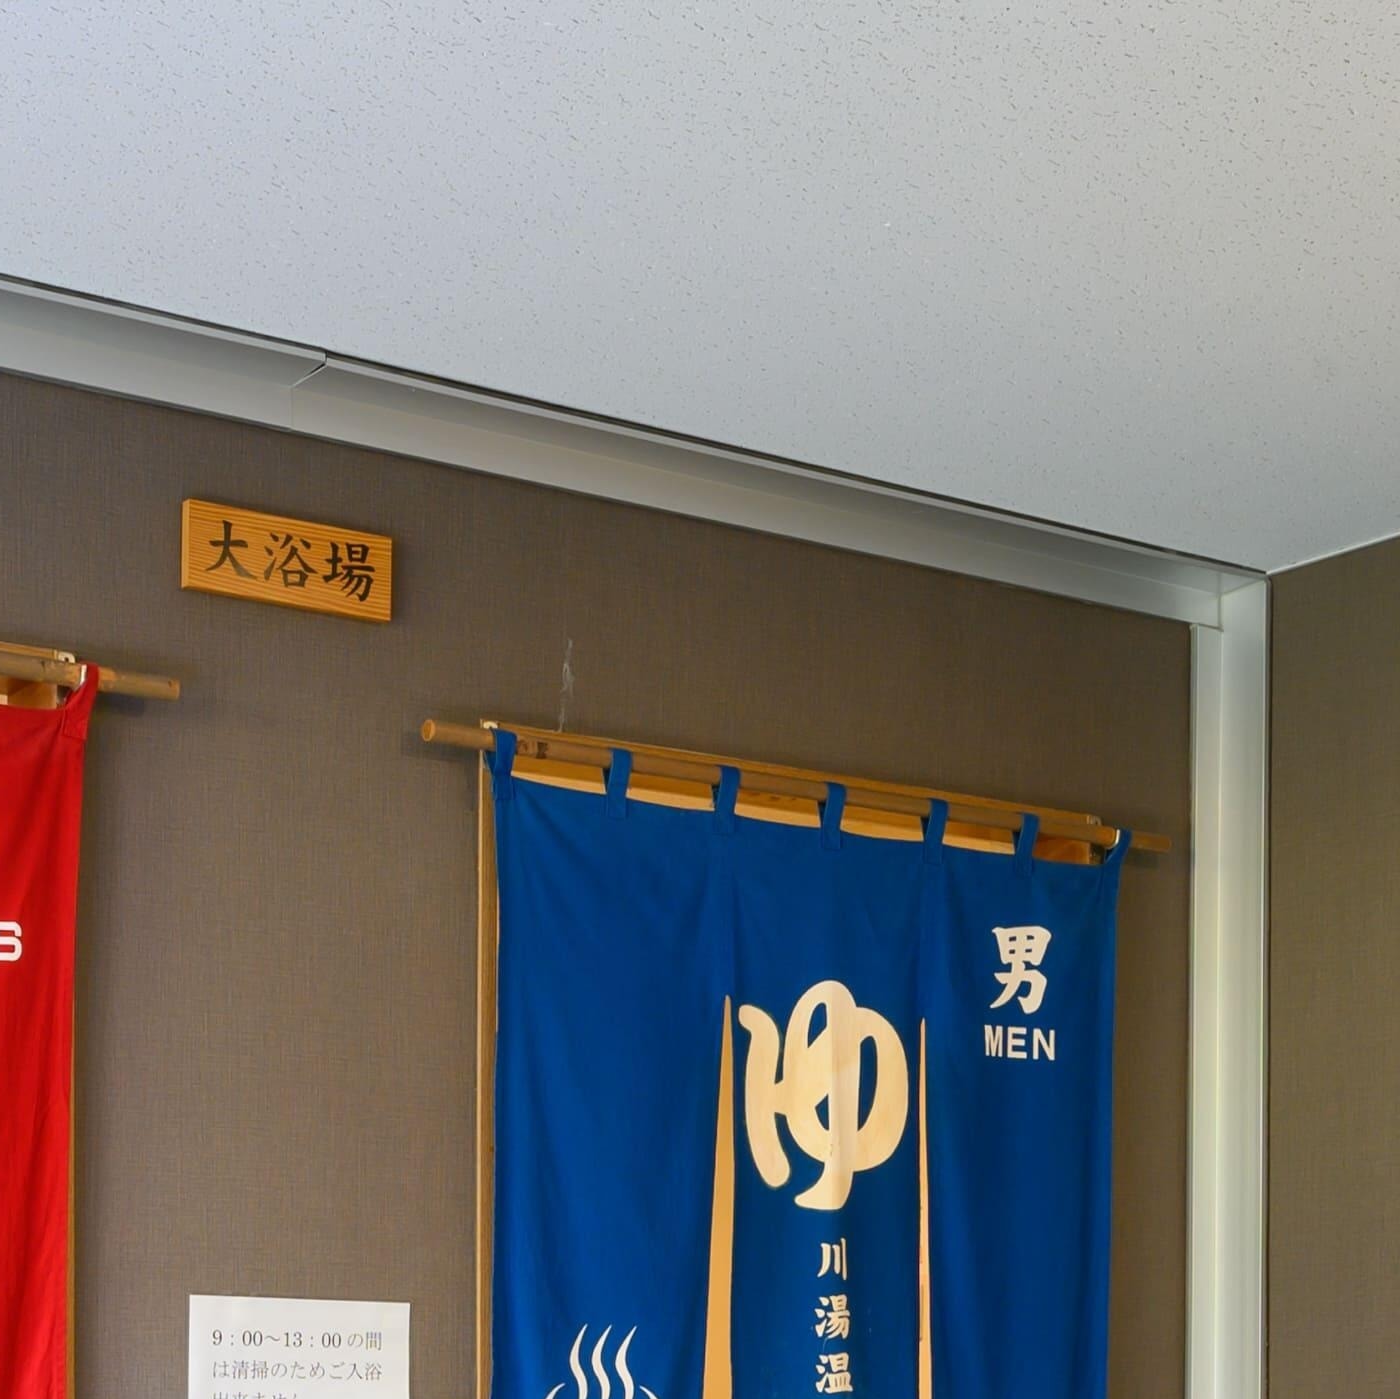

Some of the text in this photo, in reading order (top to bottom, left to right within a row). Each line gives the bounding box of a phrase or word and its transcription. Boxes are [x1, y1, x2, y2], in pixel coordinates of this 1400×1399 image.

[206, 519, 376, 603] 大浴場
[990, 926, 1051, 1014] 男
[985, 1025, 1055, 1060] MEN
[739, 980, 908, 1210] ゆ
[212, 1359, 383, 1382] は清掃のためご入浴
